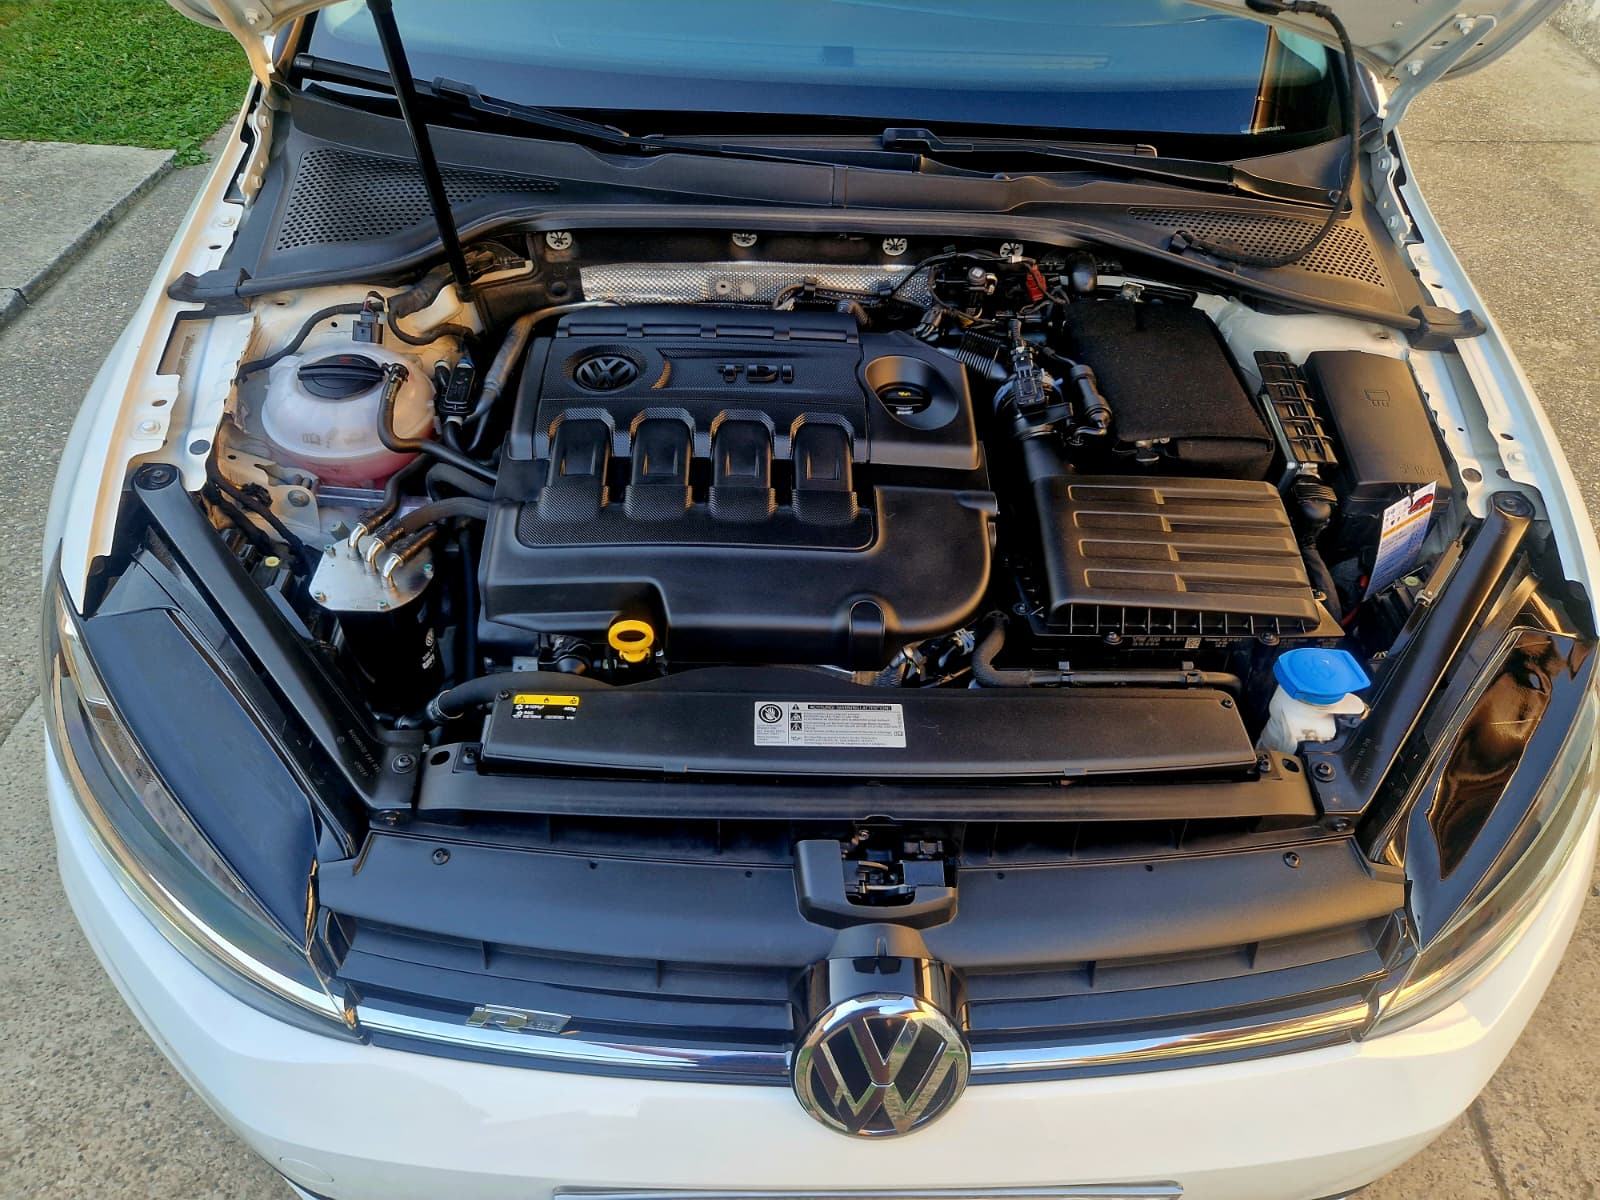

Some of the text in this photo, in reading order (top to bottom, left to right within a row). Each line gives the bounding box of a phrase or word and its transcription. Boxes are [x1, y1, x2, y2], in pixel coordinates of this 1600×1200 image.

[577, 356, 638, 390] VW
[718, 363, 795, 383] TDI
[804, 1003, 964, 1137] VW
